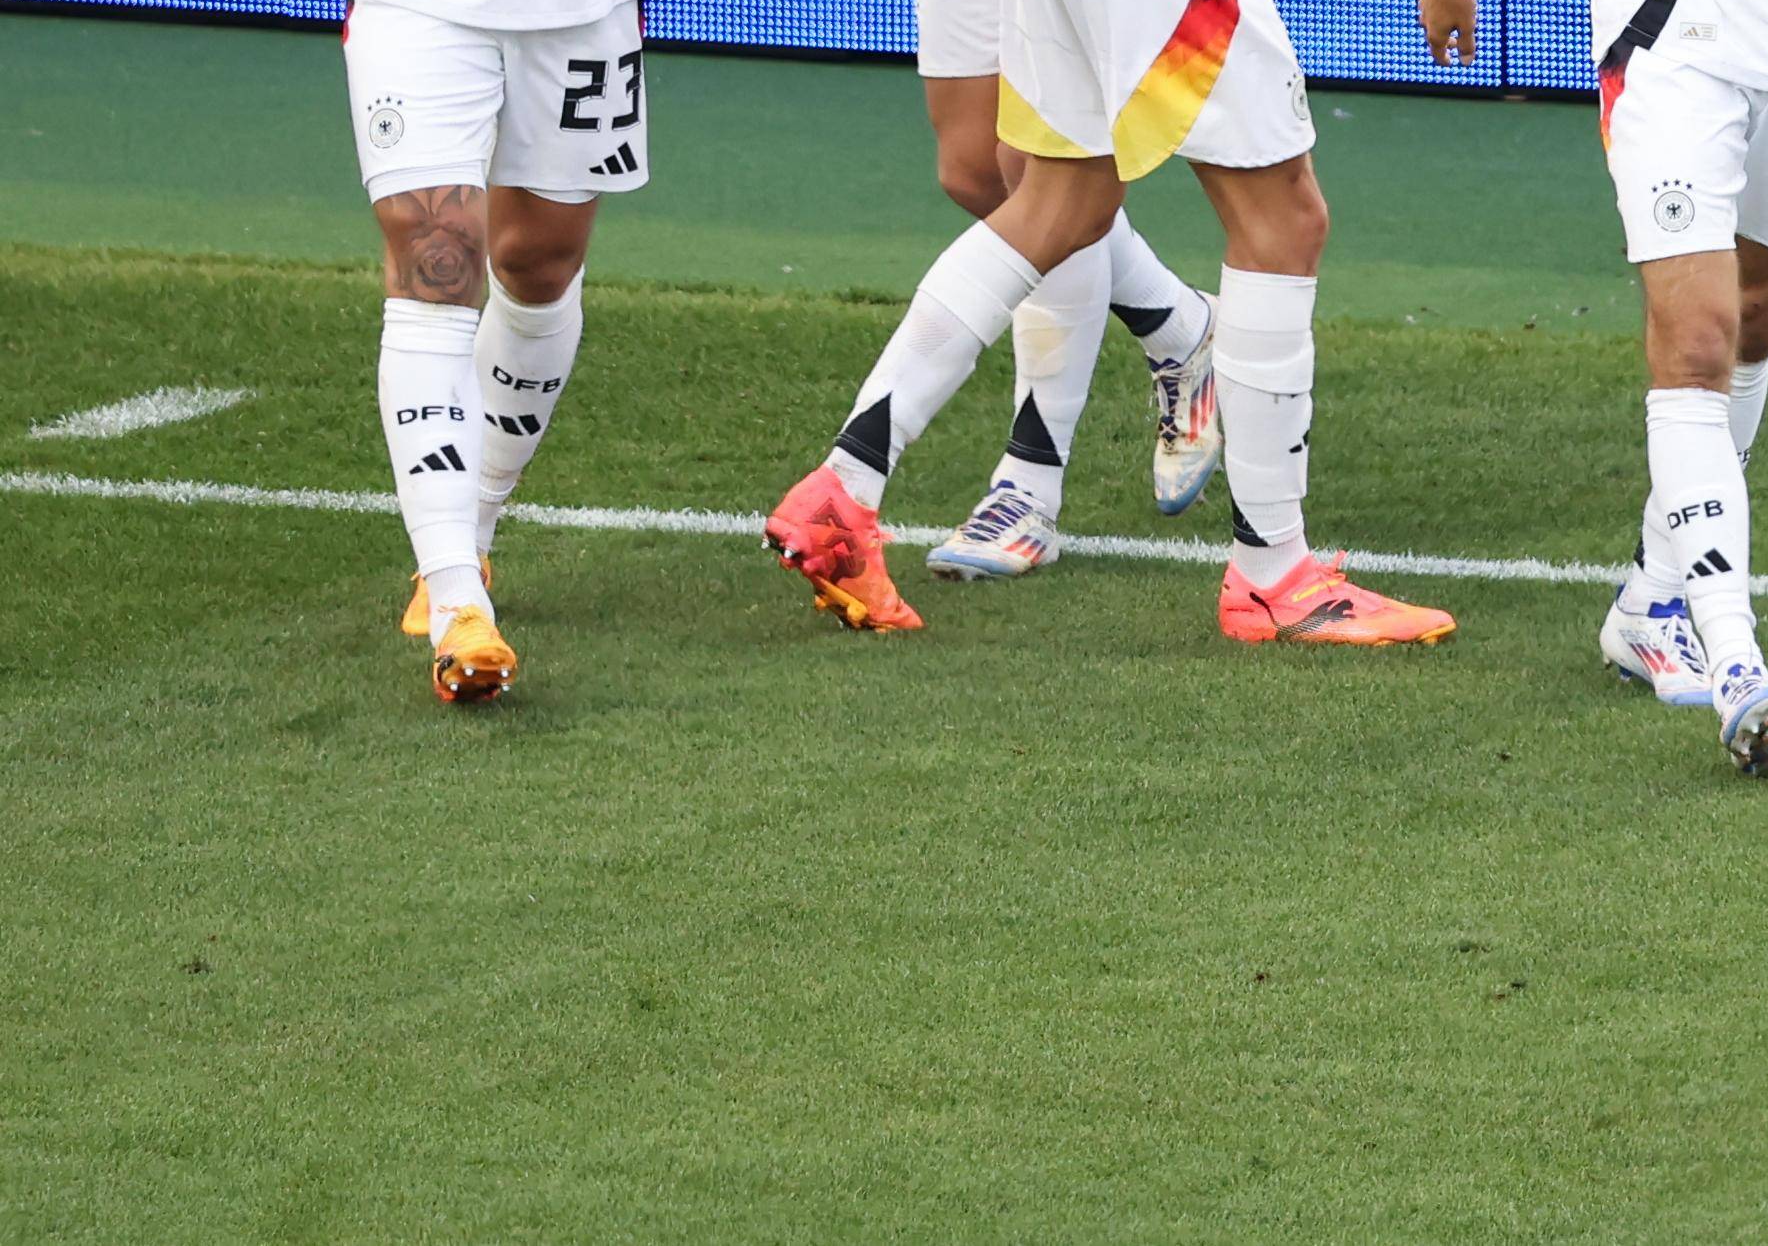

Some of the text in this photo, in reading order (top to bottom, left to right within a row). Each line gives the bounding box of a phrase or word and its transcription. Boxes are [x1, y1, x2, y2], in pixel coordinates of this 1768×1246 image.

[560, 49, 642, 133] 23
[492, 365, 561, 394] DFB
[397, 406, 465, 425] DFB
[1667, 499, 1723, 530] DFB
